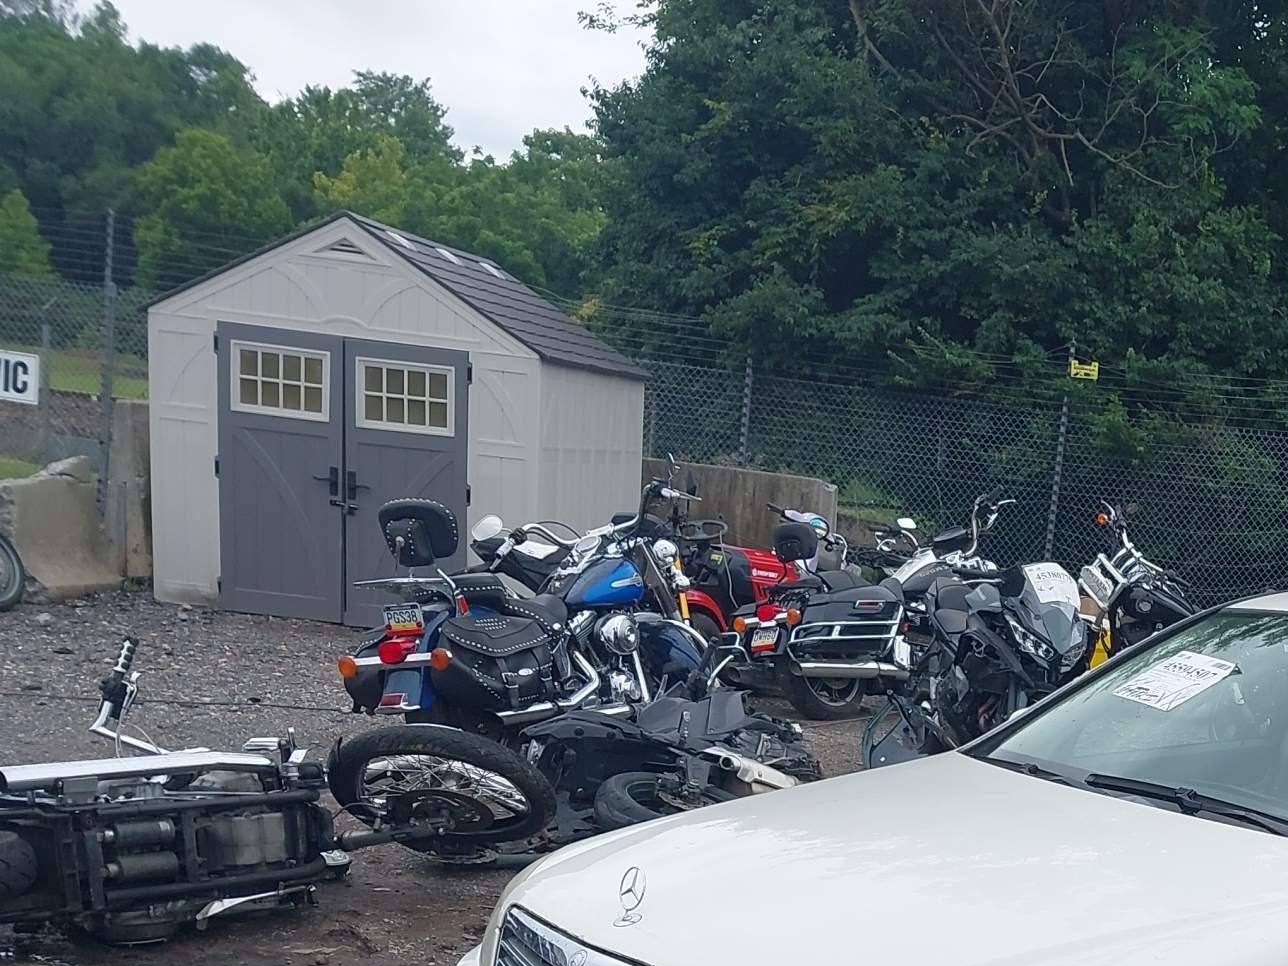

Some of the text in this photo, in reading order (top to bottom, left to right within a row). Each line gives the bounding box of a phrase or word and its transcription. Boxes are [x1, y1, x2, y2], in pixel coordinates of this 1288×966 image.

[0, 358, 29, 394] IC
[386, 610, 417, 624] PGS38
[1163, 661, 1218, 681] 45594507
